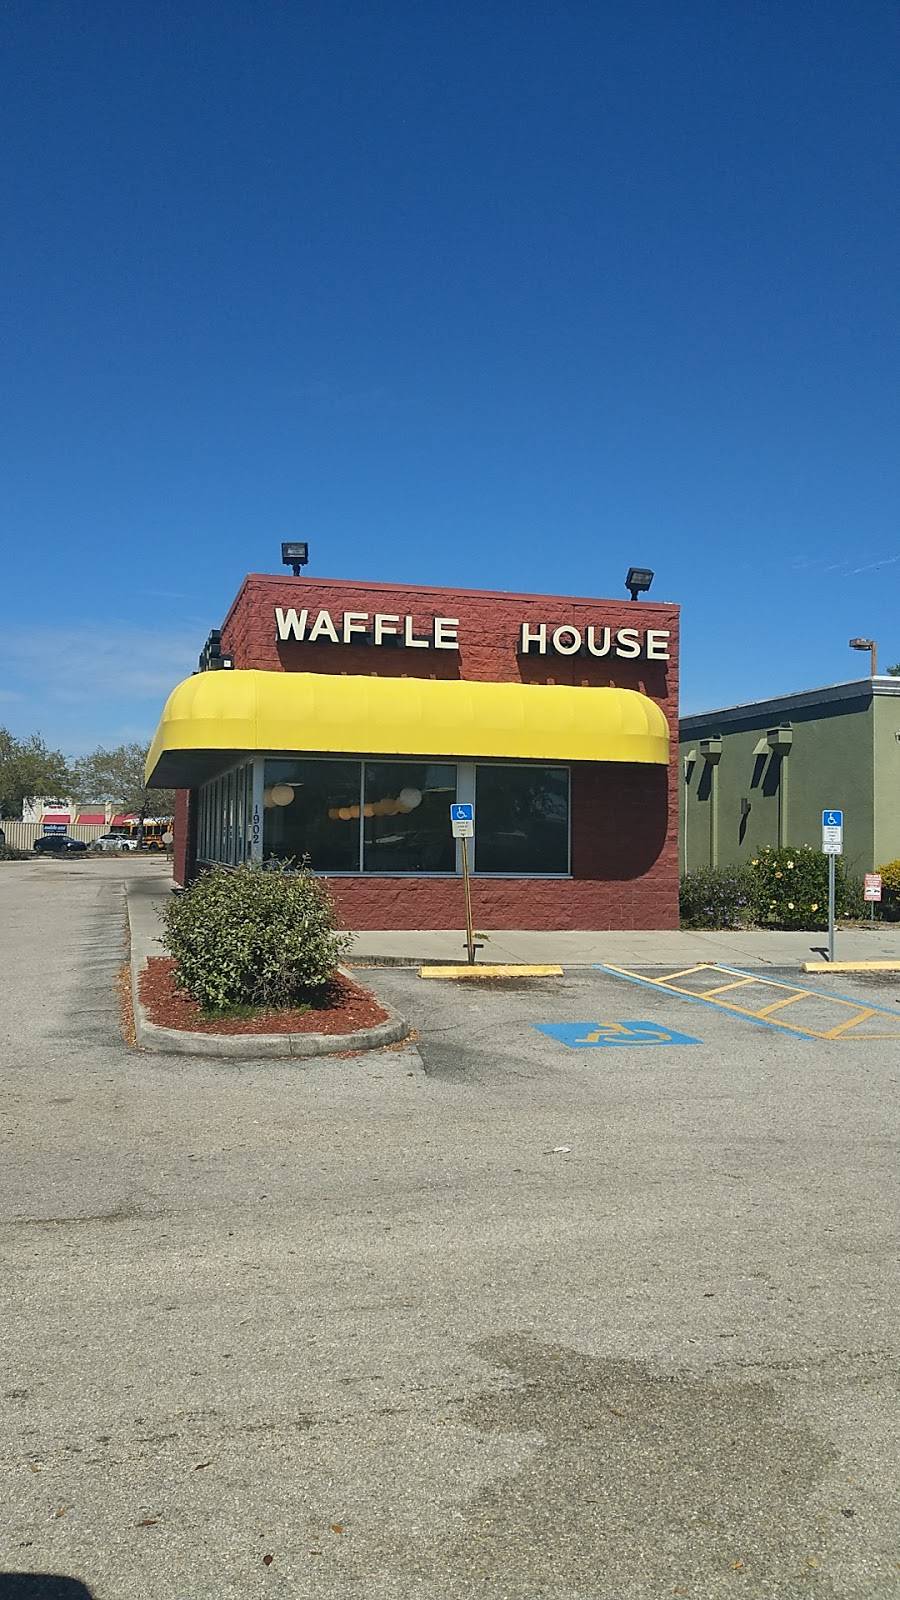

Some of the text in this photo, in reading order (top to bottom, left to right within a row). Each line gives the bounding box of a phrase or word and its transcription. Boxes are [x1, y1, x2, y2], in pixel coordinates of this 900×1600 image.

[275, 607, 671, 660] WAFFLE HOUSE
[252, 804, 260, 844] 1902
